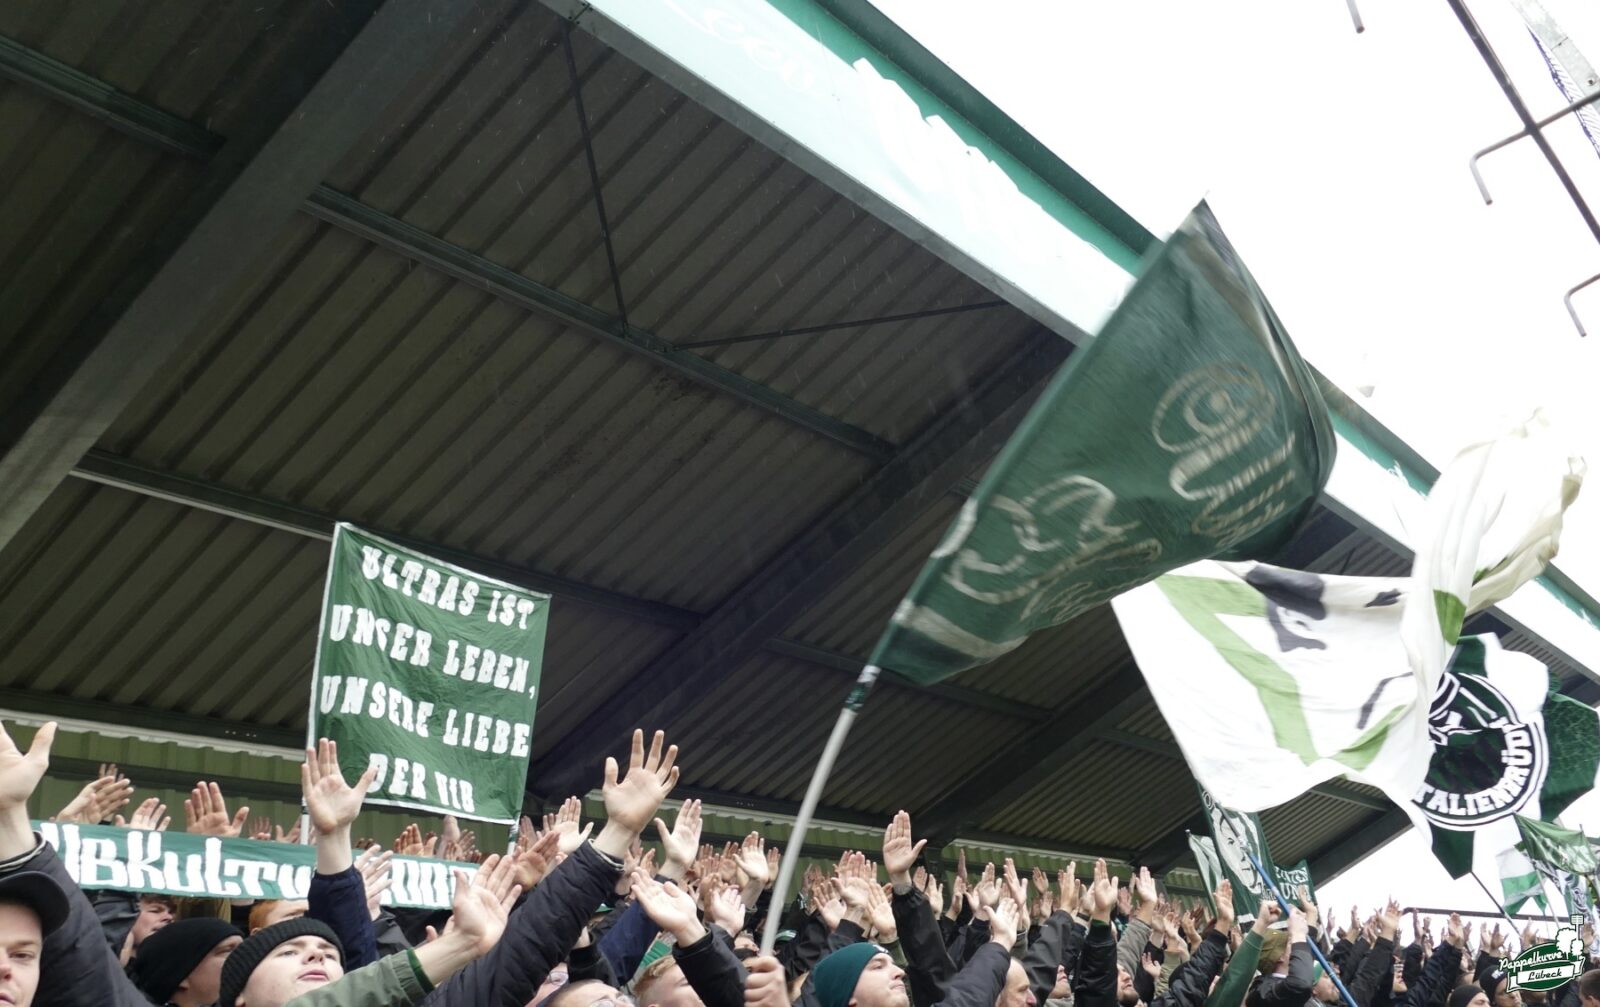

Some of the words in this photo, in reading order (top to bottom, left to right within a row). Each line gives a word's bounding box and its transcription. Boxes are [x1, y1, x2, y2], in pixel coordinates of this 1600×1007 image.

[361, 545, 480, 616] ULTRAS
[330, 604, 432, 667] UNSER
[319, 675, 434, 737] UNSERE
[443, 709, 531, 758] LIEBE
[365, 753, 427, 800] DER
